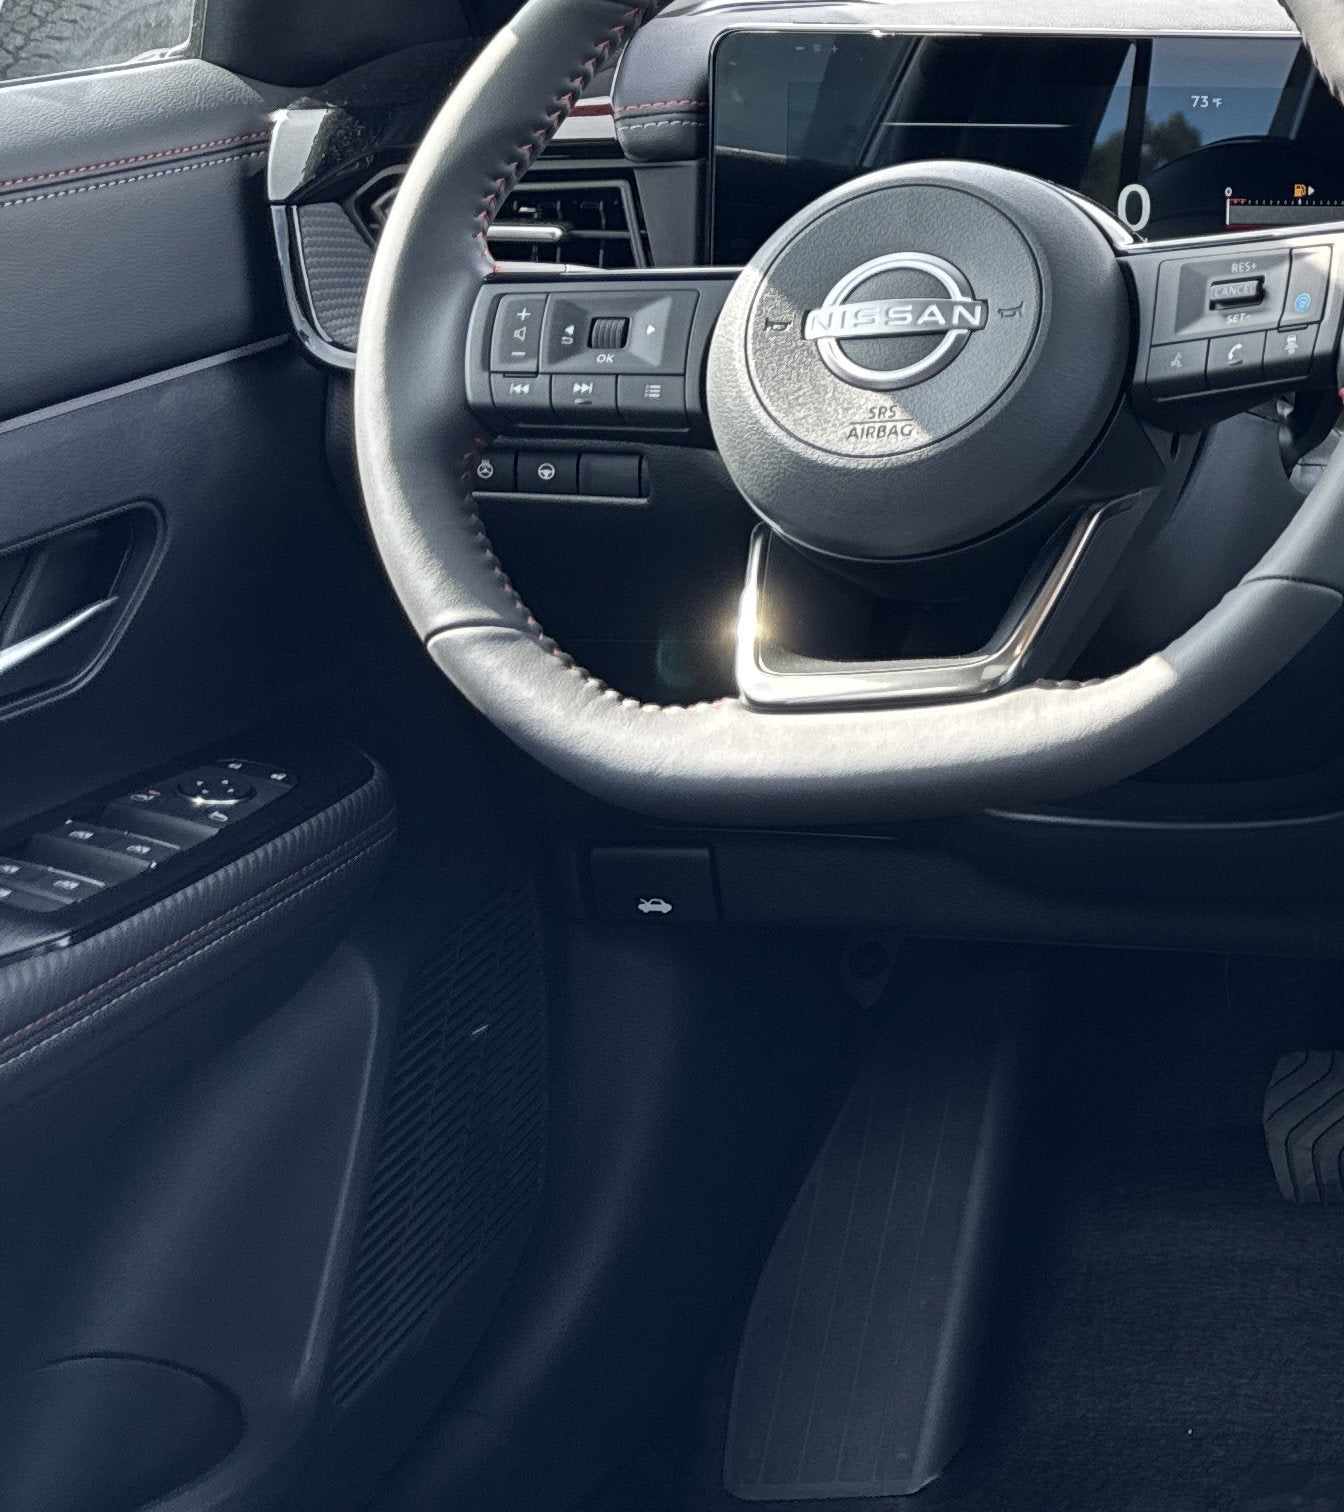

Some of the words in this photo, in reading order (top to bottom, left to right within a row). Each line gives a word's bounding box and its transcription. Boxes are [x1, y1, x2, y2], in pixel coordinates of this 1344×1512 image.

[1190, 95, 1209, 108] 73
[1224, 186, 1233, 197] 0
[1117, 183, 1151, 232] 0
[1231, 262, 1258, 274] RES+
[810, 304, 982, 331] NISSAN
[596, 353, 615, 364] OK
[868, 404, 897, 420] SRS
[847, 423, 914, 440] AIRBAG
